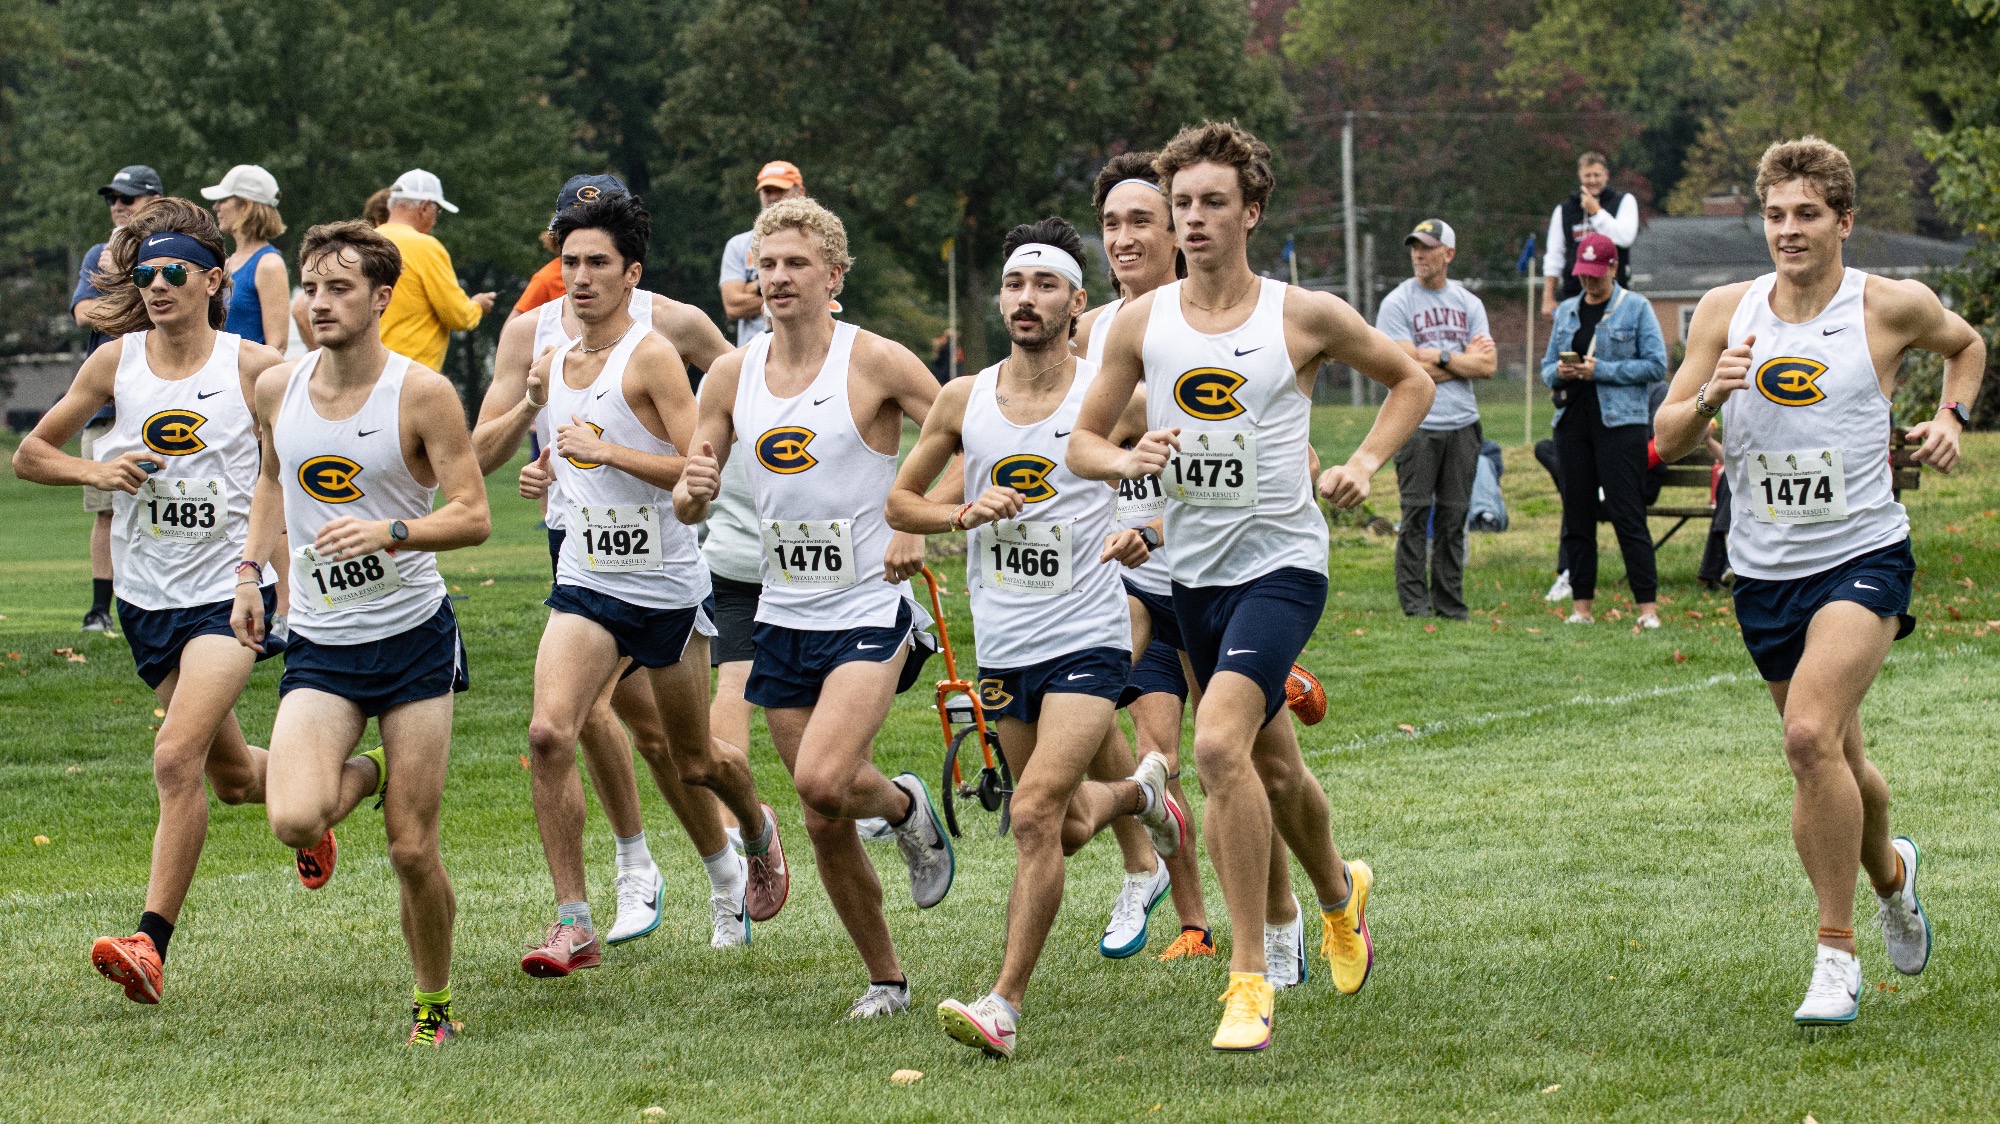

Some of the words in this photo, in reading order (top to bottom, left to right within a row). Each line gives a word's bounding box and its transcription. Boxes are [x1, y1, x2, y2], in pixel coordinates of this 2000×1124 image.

[1413, 307, 1467, 332] CALVIN
[1170, 457, 1244, 488] 1473
[1118, 474, 1162, 501] 481
[1184, 490, 1211, 498] WAYZATA
[1760, 476, 1834, 505] 1474
[147, 500, 216, 528] 1483
[1802, 507, 1830, 515] RESULTS
[583, 529, 650, 555] 1492
[774, 545, 843, 571] 1476
[990, 544, 1059, 577] 1466
[311, 555, 385, 595] 1488
[1002, 577, 1026, 585] WAYZATA
[331, 592, 358, 602] WAYZATA
[359, 582, 385, 595] RESULTS
